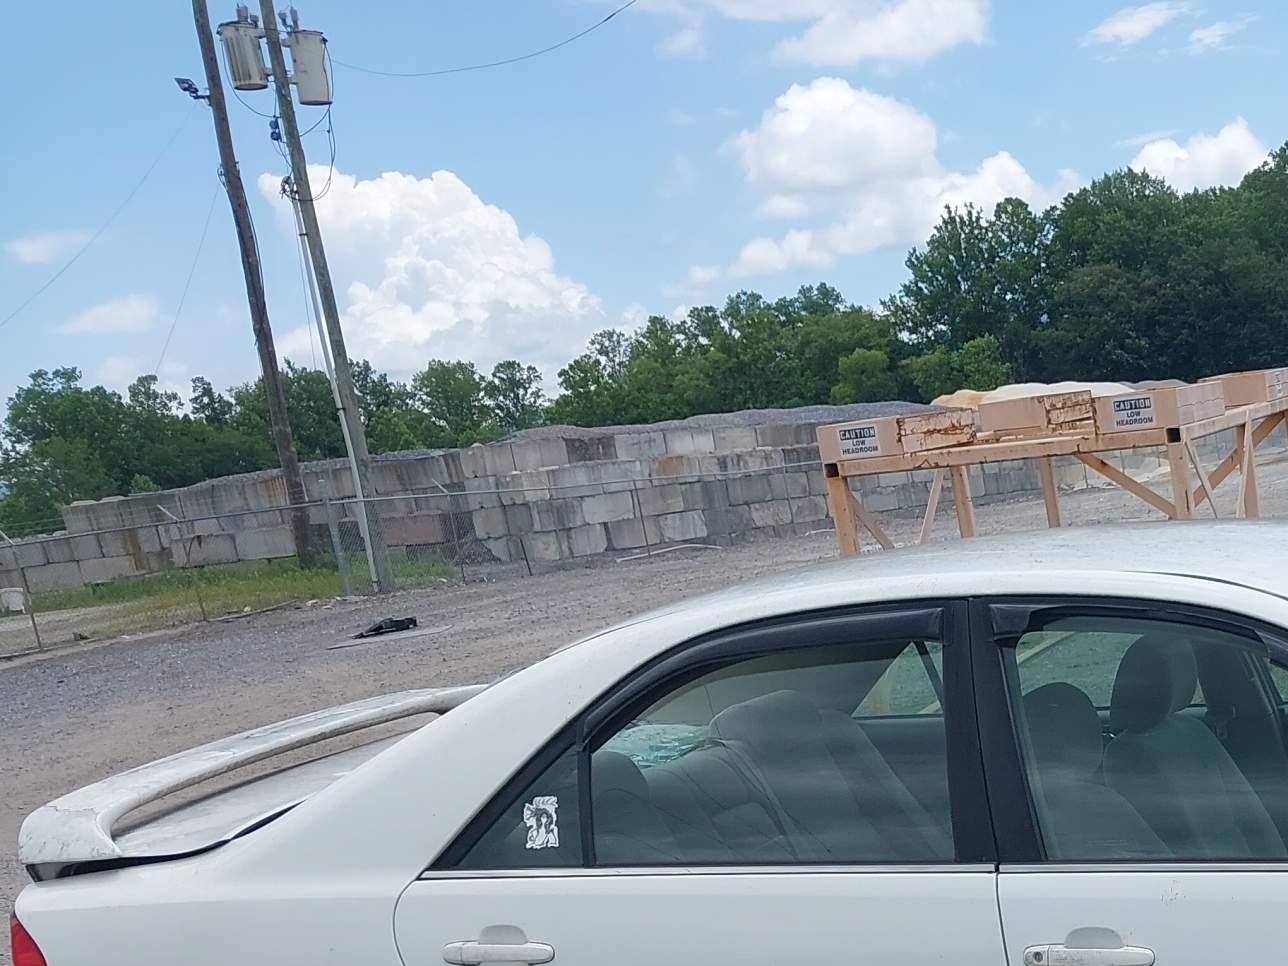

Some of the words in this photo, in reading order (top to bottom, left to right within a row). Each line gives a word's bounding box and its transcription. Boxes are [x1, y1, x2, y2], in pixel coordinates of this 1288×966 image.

[1113, 399, 1151, 411] CAUTION
[1126, 410, 1141, 418] LOW
[1116, 416, 1153, 426] HEADROOM
[840, 428, 875, 440] CAUTION
[851, 439, 866, 447] LOW
[842, 445, 879, 455] HEADROOM
